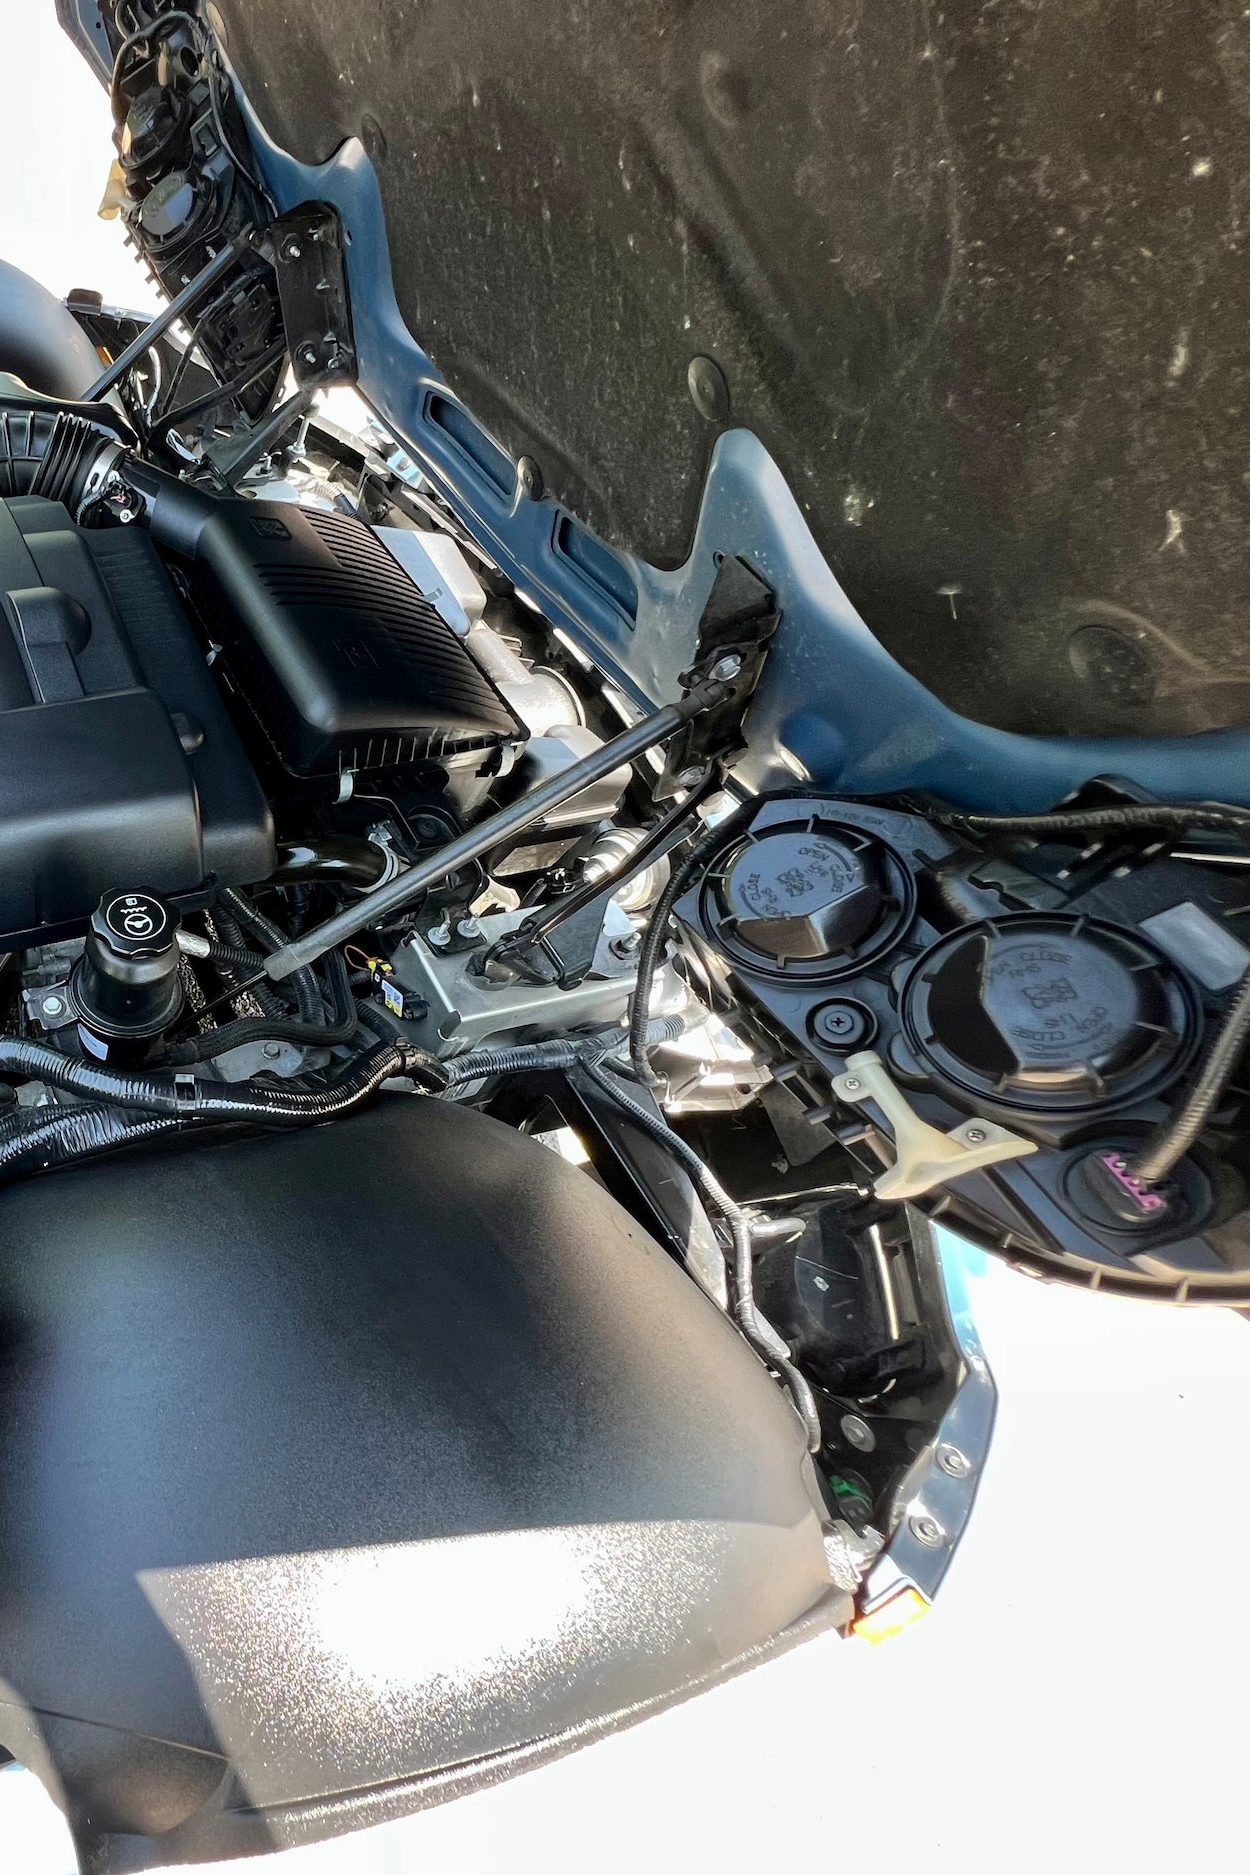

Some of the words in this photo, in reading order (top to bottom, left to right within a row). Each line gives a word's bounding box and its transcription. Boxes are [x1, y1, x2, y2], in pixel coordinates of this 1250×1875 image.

[798, 847, 830, 861] OPEN
[747, 873, 761, 901] CLOSE
[830, 864, 845, 893] CLOSE
